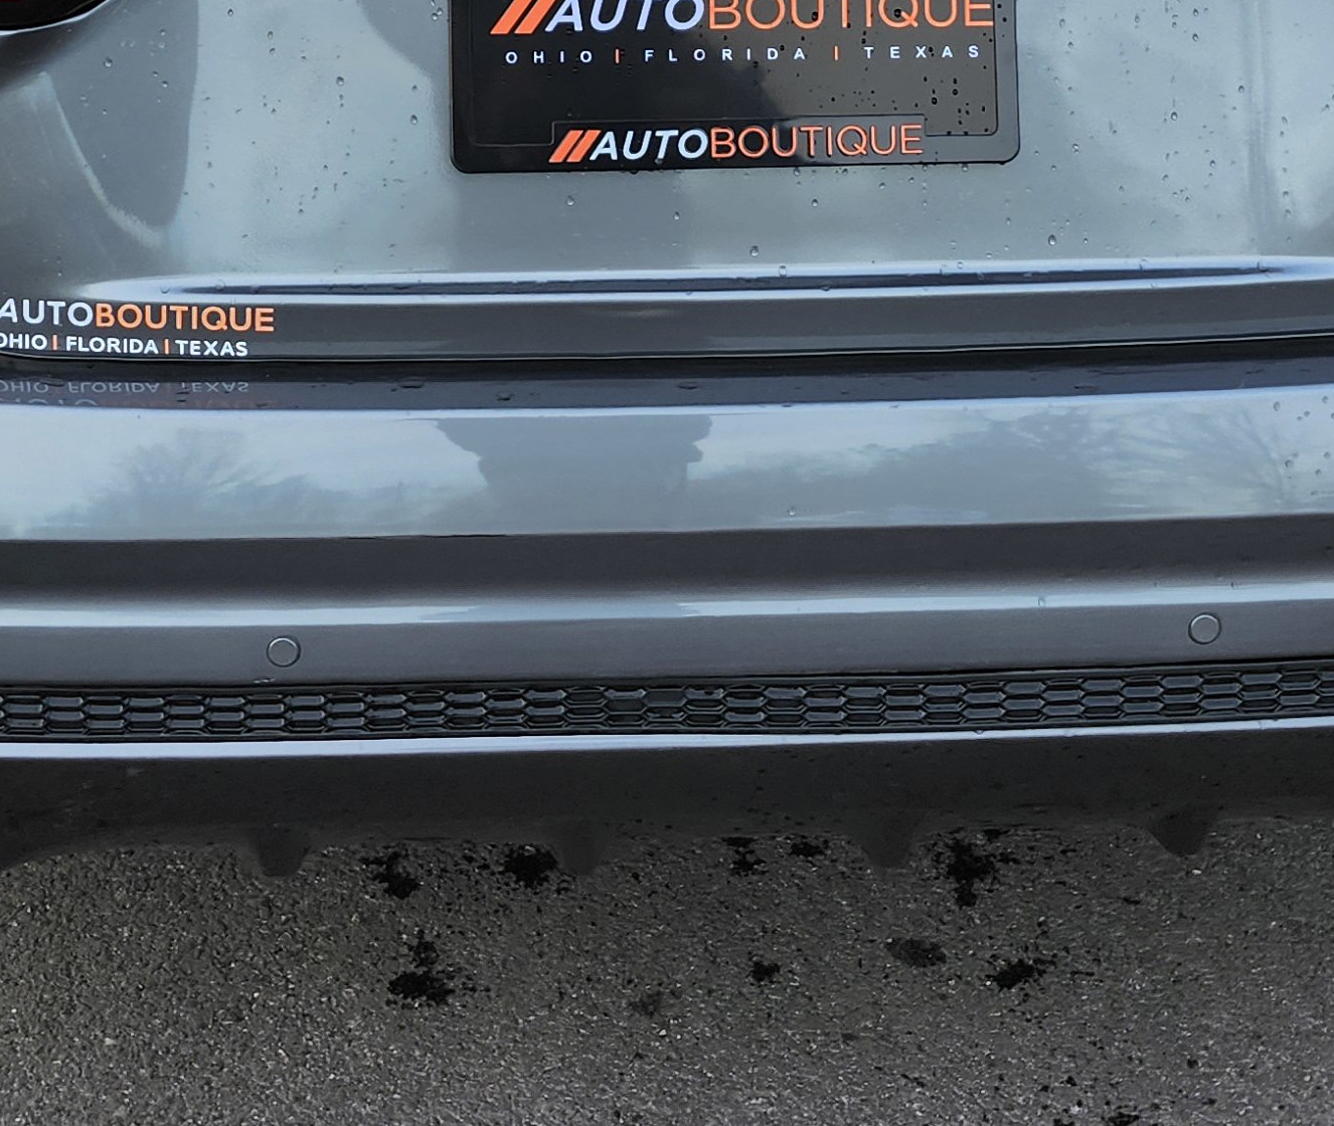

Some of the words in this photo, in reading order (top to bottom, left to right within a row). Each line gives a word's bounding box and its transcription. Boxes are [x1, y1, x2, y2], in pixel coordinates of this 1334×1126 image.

[505, 50, 593, 64] OHIO
[644, 47, 806, 63] FLORIDA
[863, 45, 980, 59] TEXAS
[589, 123, 923, 161] AUTOBOUTIQUE
[65, 335, 159, 355] FLORIDA
[175, 339, 249, 358] TEXAS
